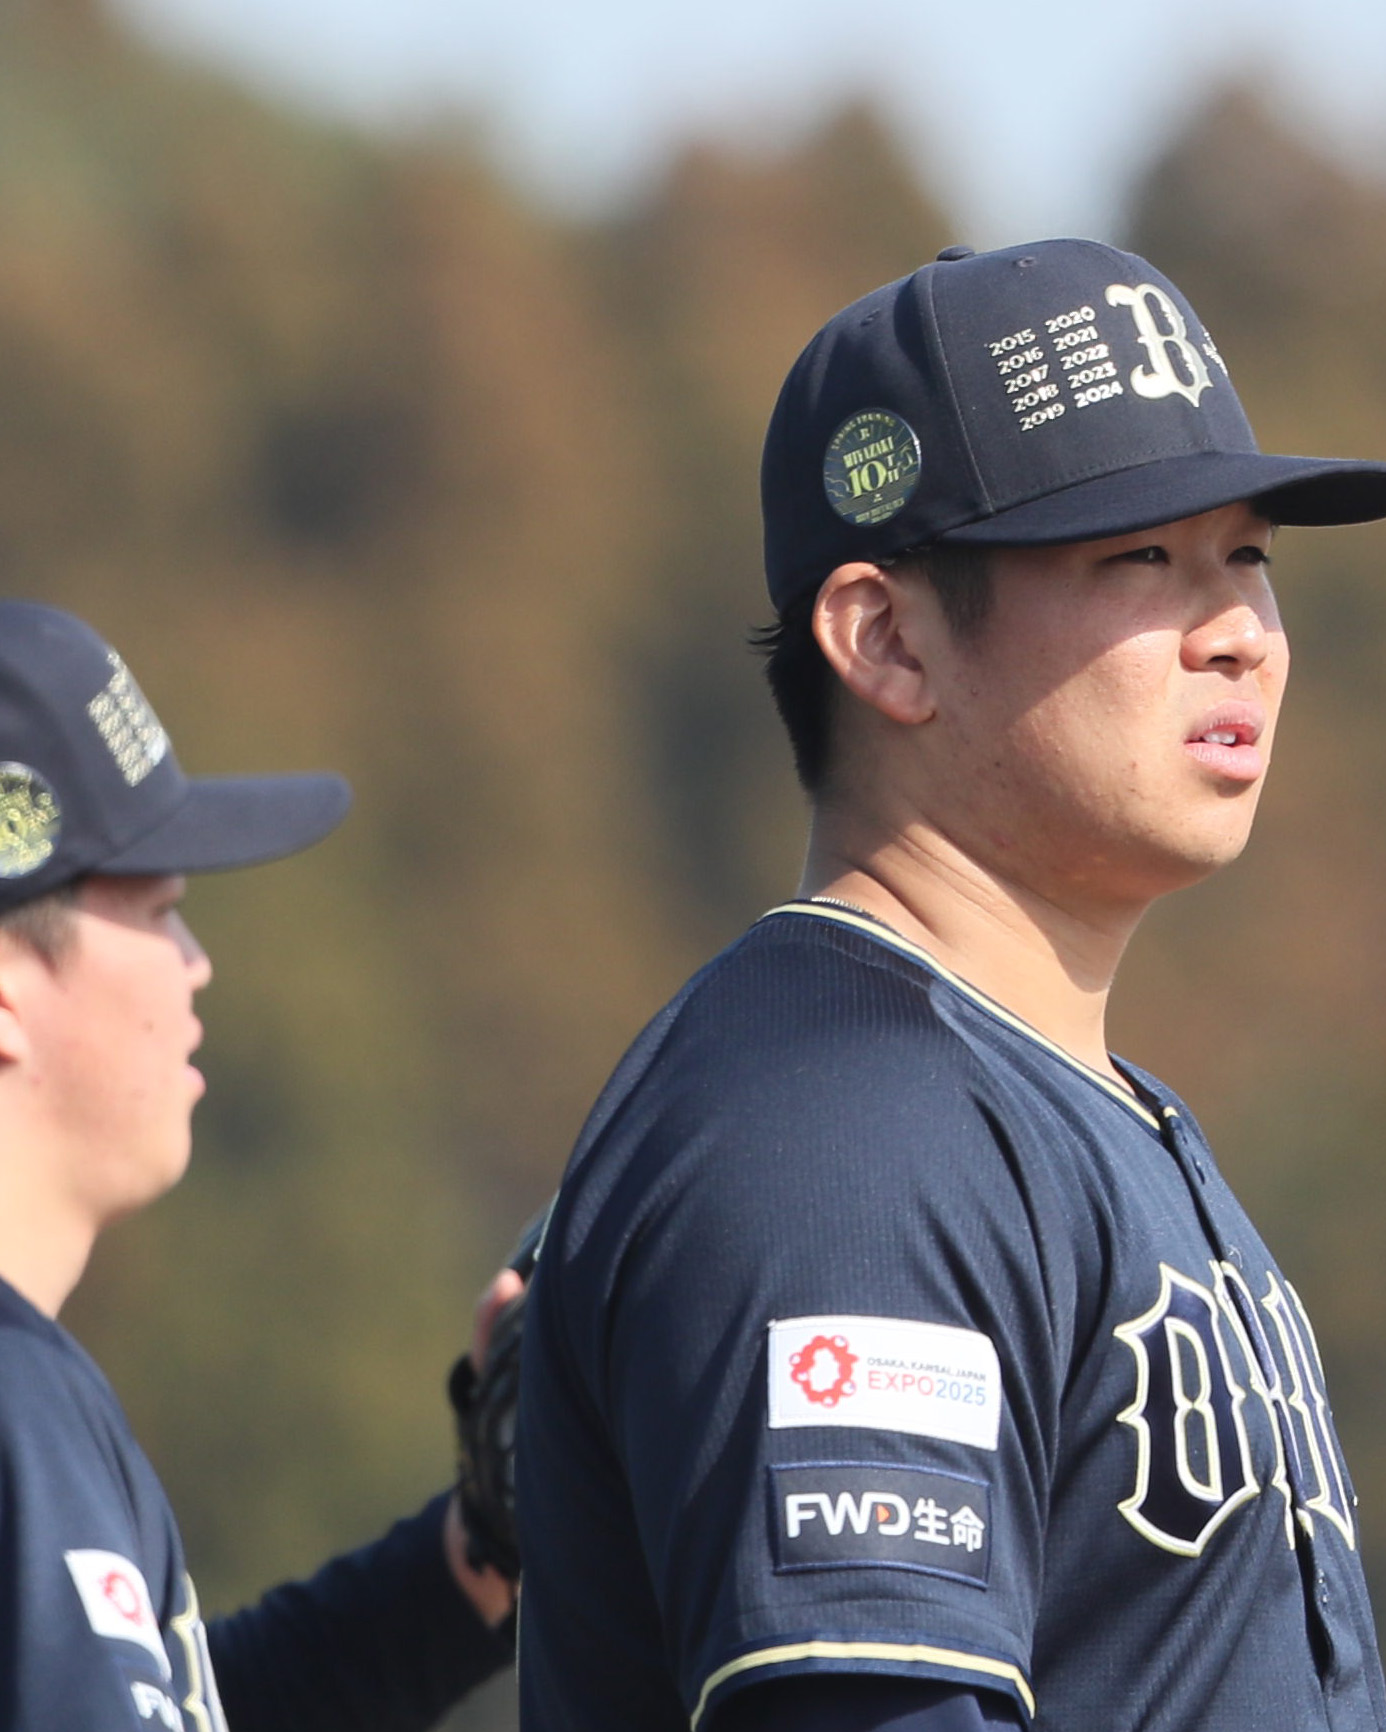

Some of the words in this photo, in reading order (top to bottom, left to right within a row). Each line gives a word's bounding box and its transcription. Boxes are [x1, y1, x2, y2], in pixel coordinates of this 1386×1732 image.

[988, 328, 1037, 357] 2015
[1044, 305, 1096, 334] 2020
[996, 346, 1044, 375] 2016
[1052, 325, 1098, 352] 2021
[1004, 364, 1049, 394] 2017
[1060, 343, 1110, 371] 2022
[1011, 383, 1060, 413] 2018
[1067, 361, 1117, 390] 2023
[1019, 403, 1066, 432] 2019
[1073, 380, 1124, 409] 2024
[868, 1370, 986, 1406] EXPO2025
[785, 1492, 986, 1554] FWD生命
